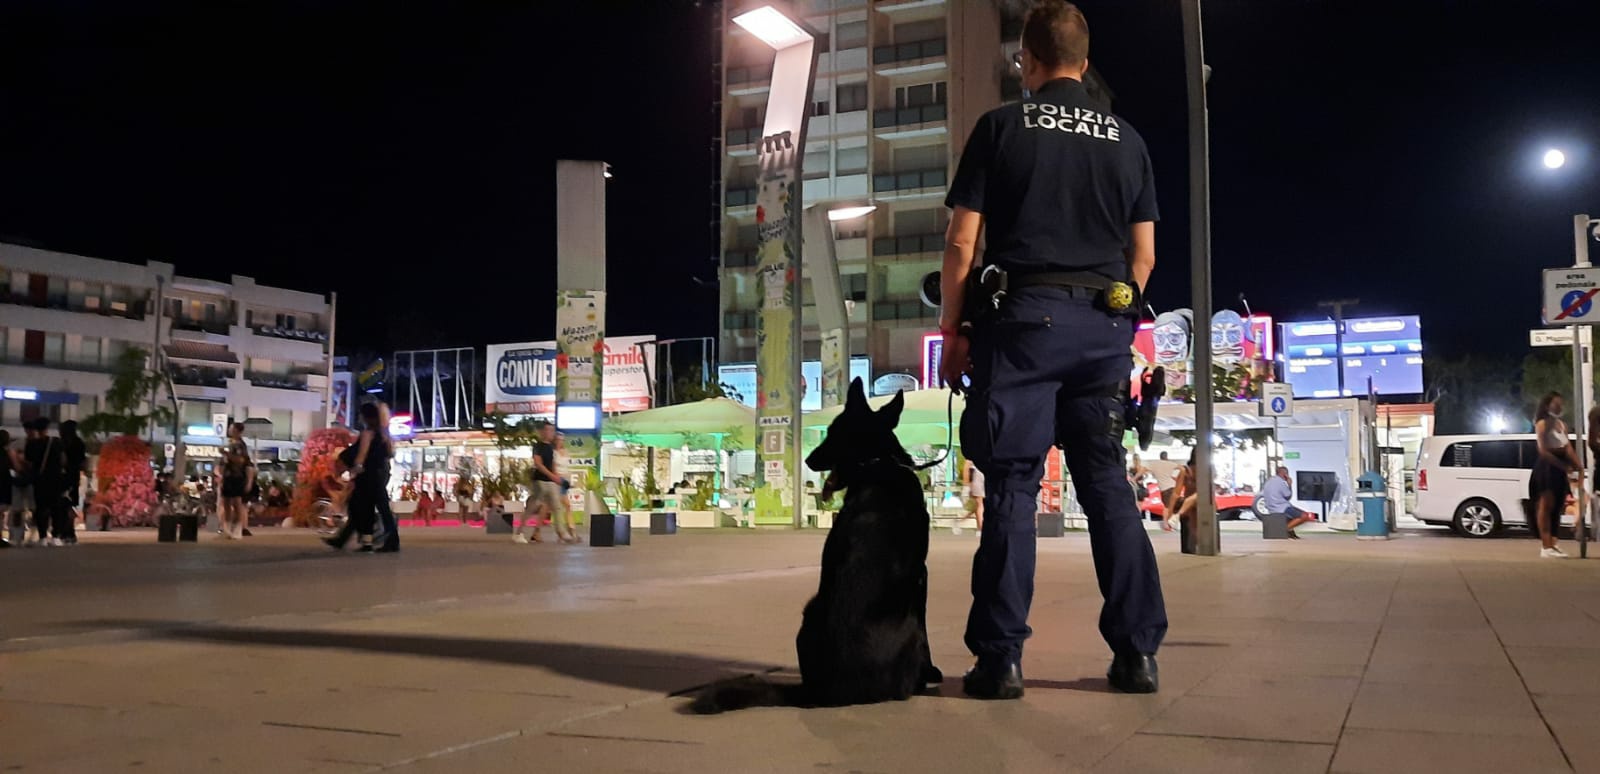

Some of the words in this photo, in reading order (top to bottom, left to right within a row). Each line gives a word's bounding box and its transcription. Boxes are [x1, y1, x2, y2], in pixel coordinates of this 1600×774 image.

[1023, 103, 1119, 128] POLIZIA
[1024, 115, 1120, 141] LOCALE
[1555, 280, 1597, 289] pedonale
